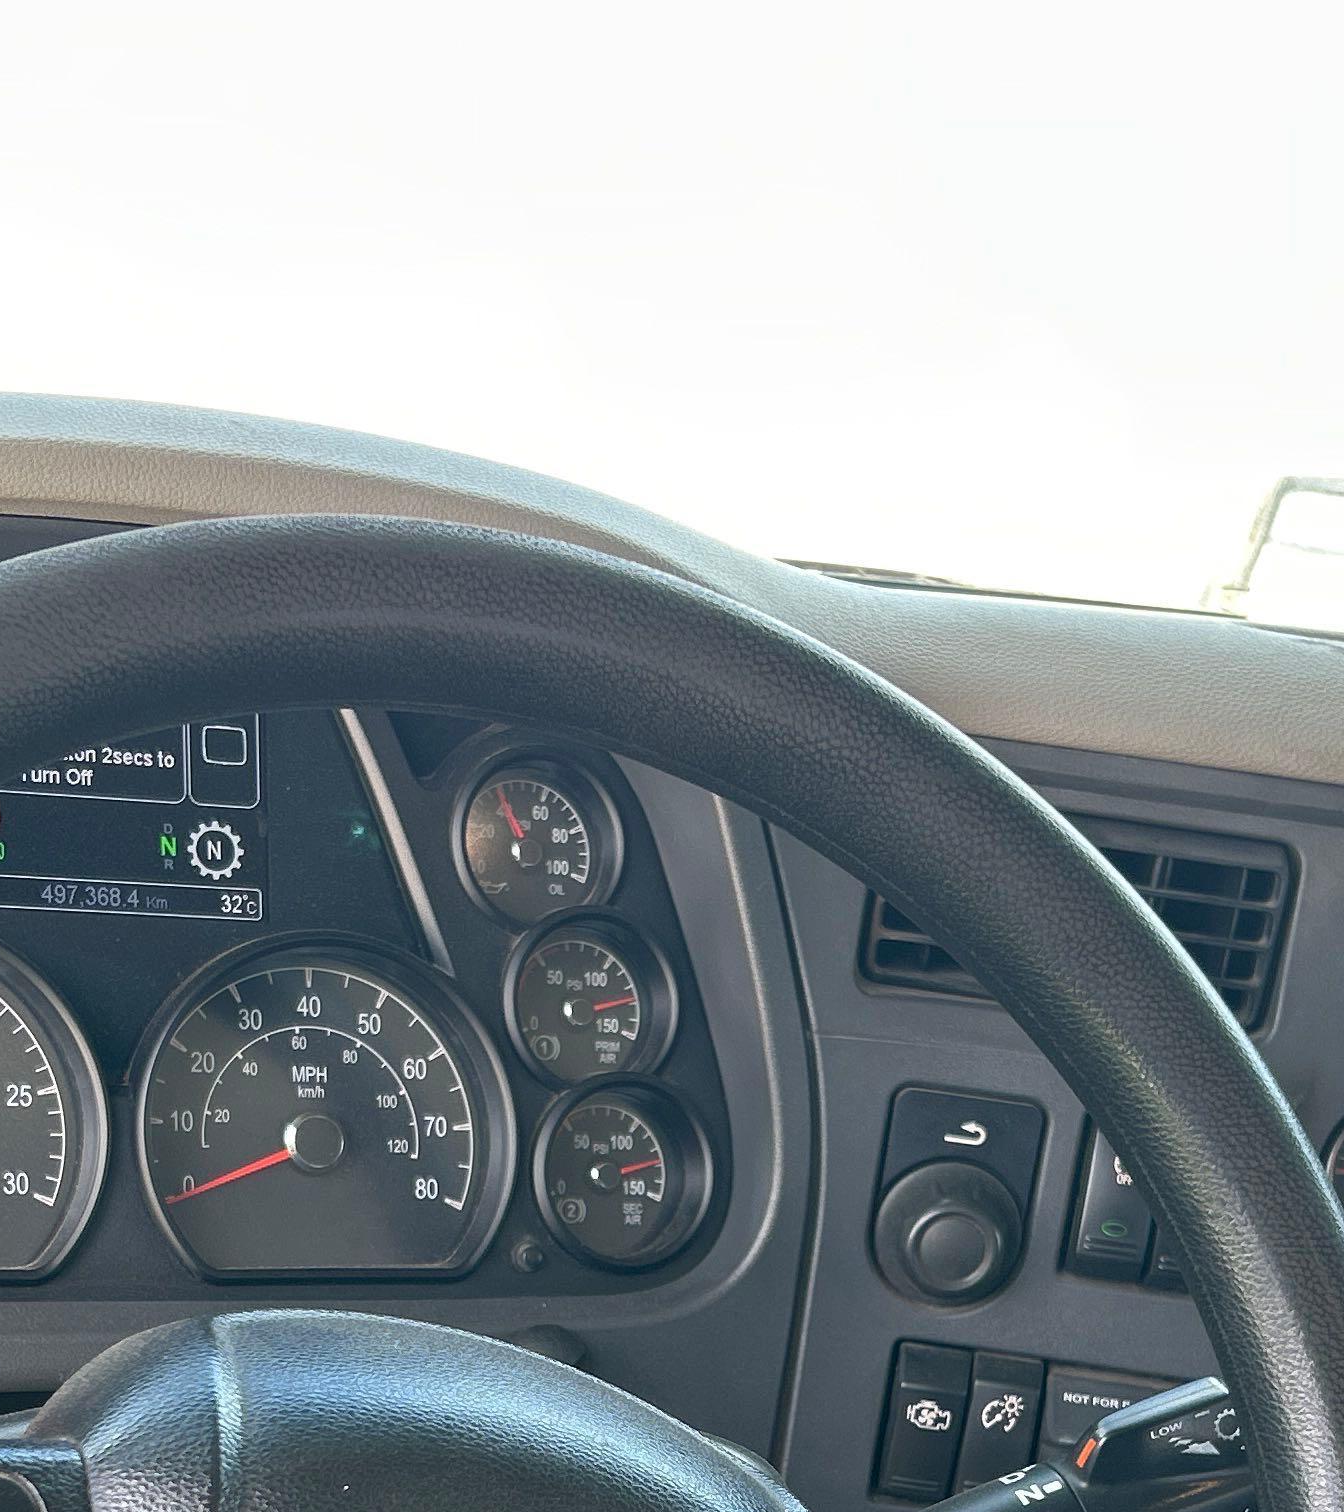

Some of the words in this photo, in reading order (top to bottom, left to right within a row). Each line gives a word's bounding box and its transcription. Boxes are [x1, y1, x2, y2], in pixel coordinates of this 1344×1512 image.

[102, 746, 154, 768] 2secs
[157, 750, 175, 768] to
[65, 768, 95, 786] Off
[532, 805, 549, 821] 60
[163, 823, 173, 834] D
[551, 828, 569, 844] 80
[159, 836, 177, 857] N
[207, 840, 222, 861] N
[164, 859, 174, 871] R
[545, 859, 570, 876] 100
[40, 884, 140, 909] 497,368.4
[546, 970, 563, 985] 50
[566, 978, 583, 991] PSI
[583, 971, 608, 987] 100
[297, 995, 322, 1018] 40
[238, 1008, 263, 1031] 30
[358, 1012, 382, 1036] 50
[595, 1018, 619, 1033] 150
[291, 1035, 307, 1051] 60
[594, 1041, 621, 1054] PRIM
[190, 1051, 216, 1074] 20
[342, 1049, 358, 1064] 80
[599, 1053, 617, 1064] AIR
[242, 1062, 258, 1077] 40
[291, 1065, 328, 1084] MPH
[402, 1057, 427, 1080] 60
[6, 1084, 33, 1108] 25
[297, 1084, 325, 1099] km/h
[375, 1093, 398, 1109] 100
[170, 1110, 194, 1133] 10
[214, 1108, 230, 1124] 20
[423, 1116, 447, 1138] 70
[386, 1138, 409, 1154] 120
[573, 1134, 590, 1149] 50
[609, 1135, 633, 1151] 100
[3, 1171, 29, 1196] 30
[182, 1174, 195, 1194] 0
[414, 1178, 439, 1201] 80
[622, 1180, 646, 1196] 150
[622, 1203, 643, 1215] SEC
[624, 1214, 642, 1226] AIR
[1063, 1391, 1089, 1405] NOT
[1092, 1395, 1118, 1409] FOR
[1150, 1420, 1183, 1440] LOW
[1014, 1484, 1045, 1507] N
